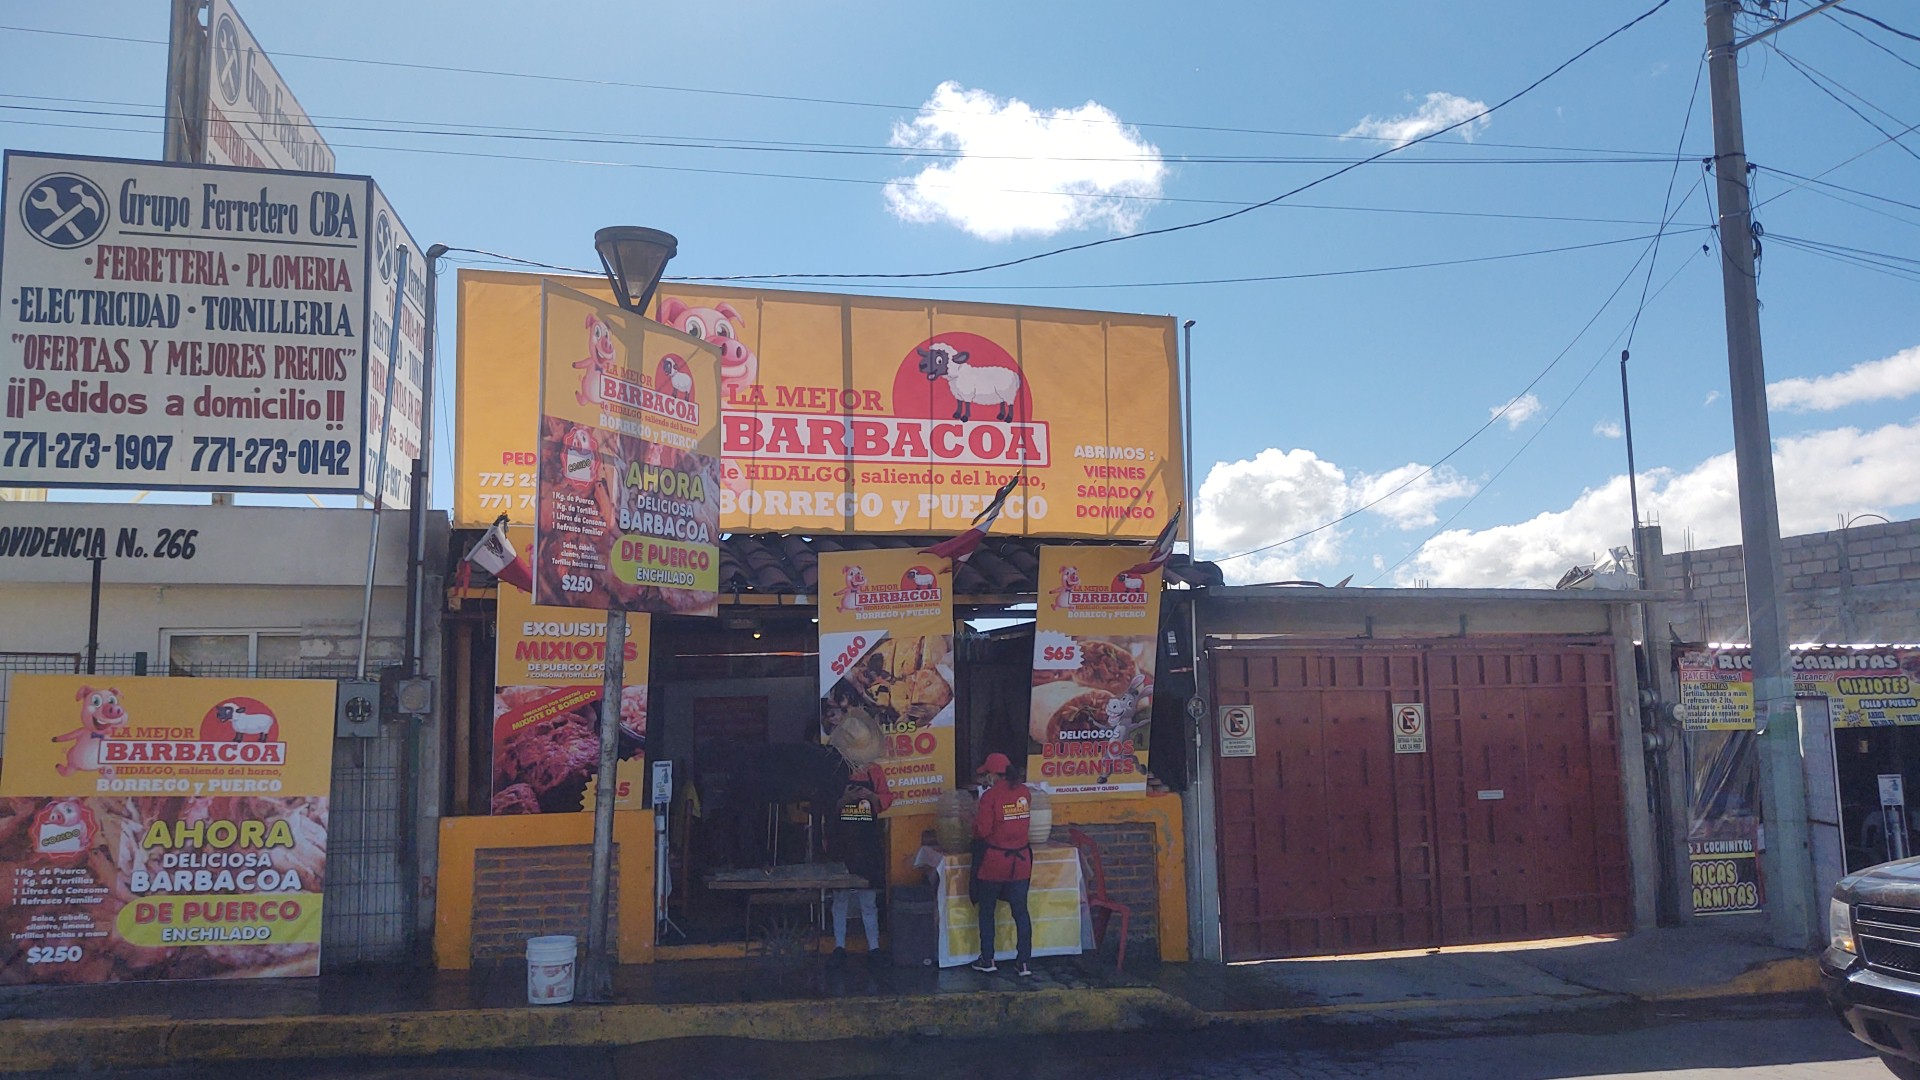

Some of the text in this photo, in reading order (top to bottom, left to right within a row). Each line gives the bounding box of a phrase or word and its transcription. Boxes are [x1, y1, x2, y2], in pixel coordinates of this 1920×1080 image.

[119, 178, 358, 239] Grupo Ferretero CBA
[94, 244, 229, 287] FERRETERIA
[246, 253, 353, 293] PLOMERIA
[19, 286, 181, 329] ELECTRICIDAD
[201, 295, 355, 337] TORNILLERIA
[140, 339, 159, 374] Y
[166, 340, 266, 378] MEJORES
[606, 362, 653, 387] LA MEJOR
[165, 394, 184, 416] a
[603, 377, 697, 422] BARBACOA
[727, 384, 883, 414] LA MEJOR
[599, 413, 698, 449] BORREGO y PUERCO
[722, 415, 1041, 461] BARBACOA
[3, 431, 351, 476] 771-273-1907 771-273-0142
[1074, 444, 1146, 460] ABRIMOS
[479, 473, 515, 487] 775
[626, 461, 705, 502] AHORA
[745, 464, 856, 487] HIDALGO,
[861, 468, 944, 485] saliendo
[950, 470, 980, 486] del
[1083, 465, 1146, 479] VIERNES
[1077, 479, 1154, 504] SÁBADO y
[479, 494, 512, 509] 771
[637, 494, 694, 518] DELICIOSA
[720, 488, 883, 518] BORREGO
[890, 499, 910, 525] y
[1076, 504, 1155, 519] DOMINGO
[619, 509, 710, 543] BARBACOA
[115, 528, 148, 558] No.
[153, 528, 199, 559] 266
[621, 540, 710, 571] DE PUERCO
[561, 574, 593, 593] $250
[636, 566, 695, 585] ENCHILADO
[858, 590, 940, 604] BARBACOA
[1071, 593, 1146, 603] BARBACOA
[522, 622, 632, 637] EXQUISITS
[515, 640, 639, 661] MIXIOTS
[831, 635, 866, 676] $260
[1043, 645, 1075, 662] $65
[528, 663, 591, 672] DE PUERCO Y
[1791, 654, 1898, 670] CARNITAS
[1840, 677, 1909, 695] MIXIOTES
[511, 690, 597, 731] MIXIOTE DE BORREGO
[110, 727, 195, 740] LA MEJOR
[1059, 729, 1120, 739] DELICIOSOS
[105, 742, 281, 762] BARBACOA
[1043, 740, 1134, 759] BURRITOS
[884, 763, 935, 776] CONSOME
[1041, 757, 1134, 777] GIGANTES
[96, 778, 282, 795] BORREGO y PUERCO
[898, 774, 944, 787] FAMILIAR
[907, 787, 944, 799] COMAL
[143, 819, 294, 849] AHORA
[162, 852, 272, 868] DELICIOSA
[39, 867, 87, 875] de Puerco
[1692, 863, 1737, 885] RICAS
[56, 877, 94, 885] Tortillas
[130, 869, 302, 893] BARBACOA
[21, 896, 62, 905] Refresco
[65, 895, 103, 904] Familiar
[22, 887, 49, 895] Litros
[51, 887, 63, 895] de
[135, 900, 302, 923] DE PUERCO
[161, 926, 272, 942] ENCHILADO
[26, 945, 83, 964] $250
